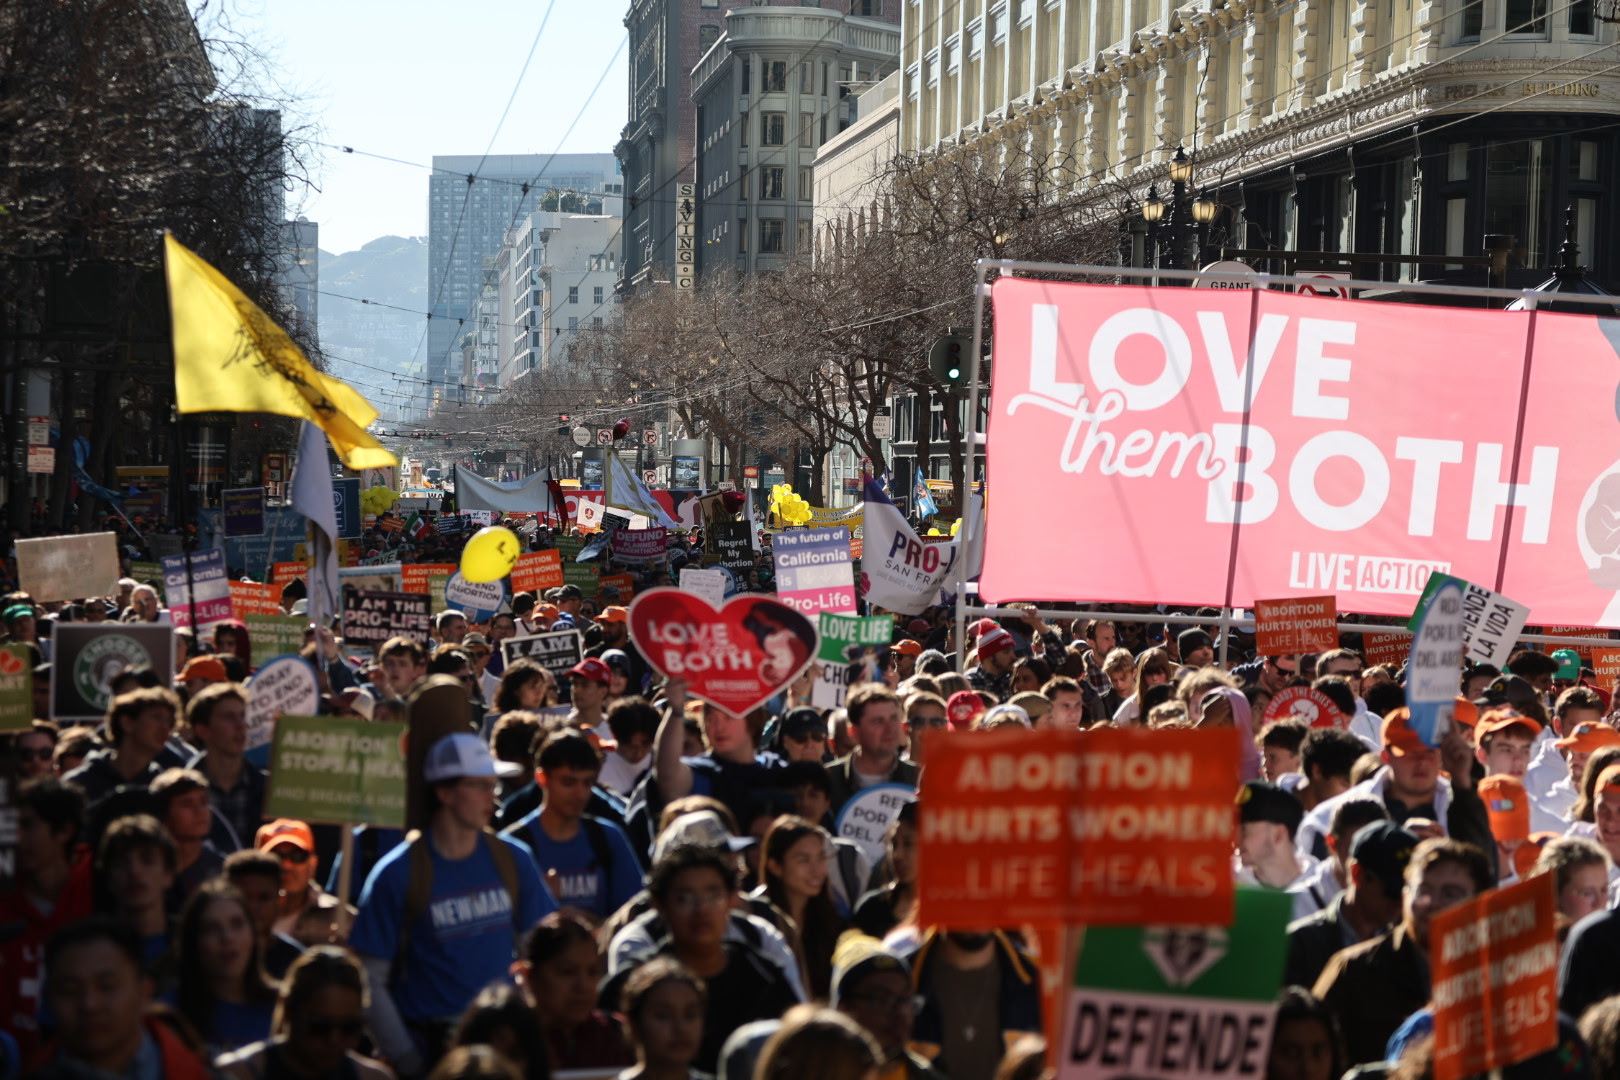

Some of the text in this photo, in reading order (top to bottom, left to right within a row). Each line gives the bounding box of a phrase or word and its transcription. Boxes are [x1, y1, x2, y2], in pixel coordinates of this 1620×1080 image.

[1522, 82, 1600, 97] BUILDING
[1210, 281, 1251, 289] GRANT
[1029, 303, 1357, 421] LOVE
[1007, 387, 1226, 481] them
[1204, 422, 1560, 545] BOTH
[616, 529, 664, 541] DEFUND
[718, 539, 748, 548] Regret
[778, 530, 844, 545] The future of
[615, 545, 664, 554] PARENTHOOD
[727, 550, 740, 558] My
[778, 549, 849, 567] California
[164, 551, 220, 568] The fture of
[514, 555, 553, 567] ABORTION
[885, 560, 911, 577] SAN
[166, 567, 223, 585] Calornia
[407, 568, 448, 576] ABORTION
[510, 564, 560, 577] HURTS WOMEN
[535, 573, 560, 584] HEALS
[1289, 550, 1354, 592] LIVE
[474, 580, 496, 592] END
[779, 574, 792, 587] is
[451, 583, 500, 601] ABORTION
[782, 591, 851, 611] Pro-Life
[243, 599, 279, 608] WOMEN
[348, 598, 426, 613] I AM THE
[1264, 603, 1325, 617] ABORTION
[173, 604, 230, 623] Pr-Life
[344, 609, 430, 630] PRO-LIFE
[345, 626, 428, 642] GENERATION
[647, 619, 730, 646] LOVE
[821, 615, 890, 642] LOVE LIFE
[1256, 617, 1336, 632] HURTS WOMEN
[1473, 603, 1515, 659] LA VIDA
[510, 635, 574, 658] I AM
[1260, 632, 1334, 648] ...LIFE HEALS
[1365, 644, 1396, 655] HURTS
[663, 648, 753, 673] BOTH
[255, 664, 293, 693] PRAY
[250, 674, 304, 713] TO END
[1295, 687, 1308, 698] THE
[1310, 690, 1332, 708] CRIES
[1328, 705, 1339, 715] OF
[281, 730, 390, 755] ABORTION
[279, 752, 345, 774] STOPS
[346, 758, 360, 775] A
[957, 752, 1193, 792] ABORTION
[853, 806, 888, 825] POR
[921, 803, 1235, 843] HURTS WOMEN
[842, 822, 874, 843] DEL
[1071, 855, 1217, 898] HEALS
[430, 888, 512, 928] NEWMAN
[1442, 899, 1536, 967] ABORTION
[1432, 939, 1557, 1011] HURTS WOMEN
[1069, 1002, 1265, 1075] DEFIENDE
